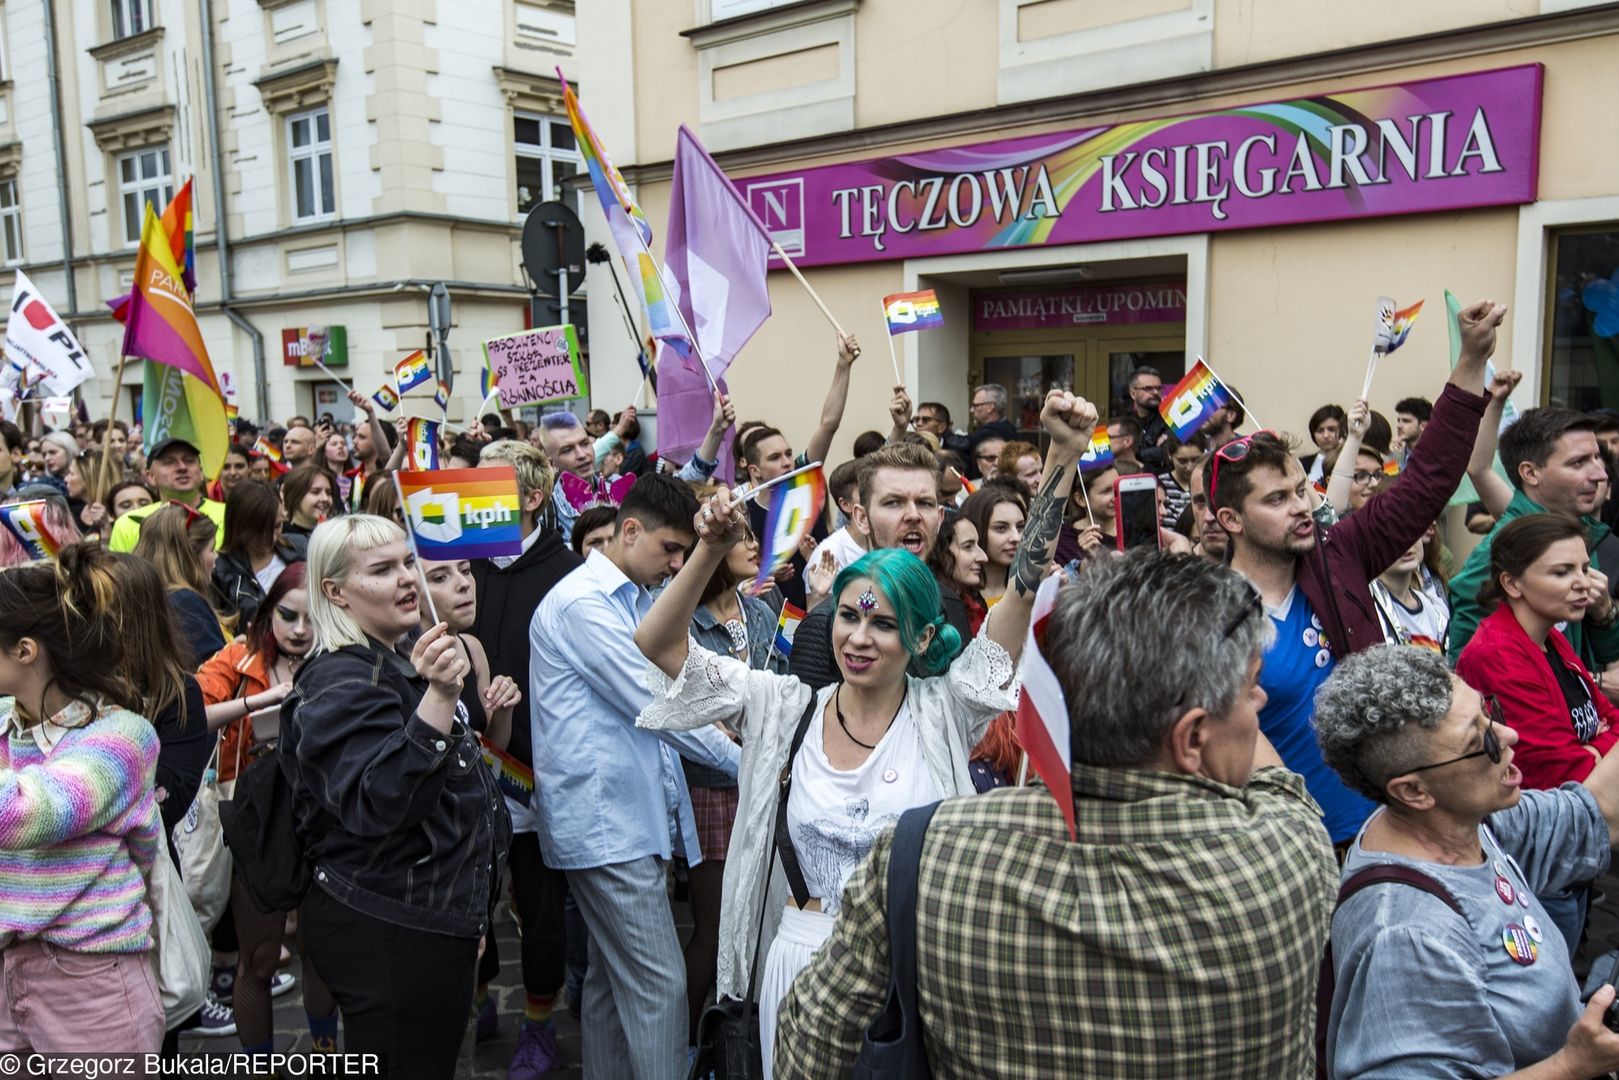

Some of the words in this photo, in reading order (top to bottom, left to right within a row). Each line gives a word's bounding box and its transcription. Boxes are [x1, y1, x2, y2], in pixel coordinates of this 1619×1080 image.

[832, 163, 1062, 251] TĘCZOWA
[1097, 105, 1505, 221] KSIĘGARNIA
[761, 188, 788, 228] N
[982, 295, 1083, 321] PAMIĄTKI
[48, 330, 83, 371] PL
[518, 373, 538, 386] ZA
[463, 501, 513, 530] kph
